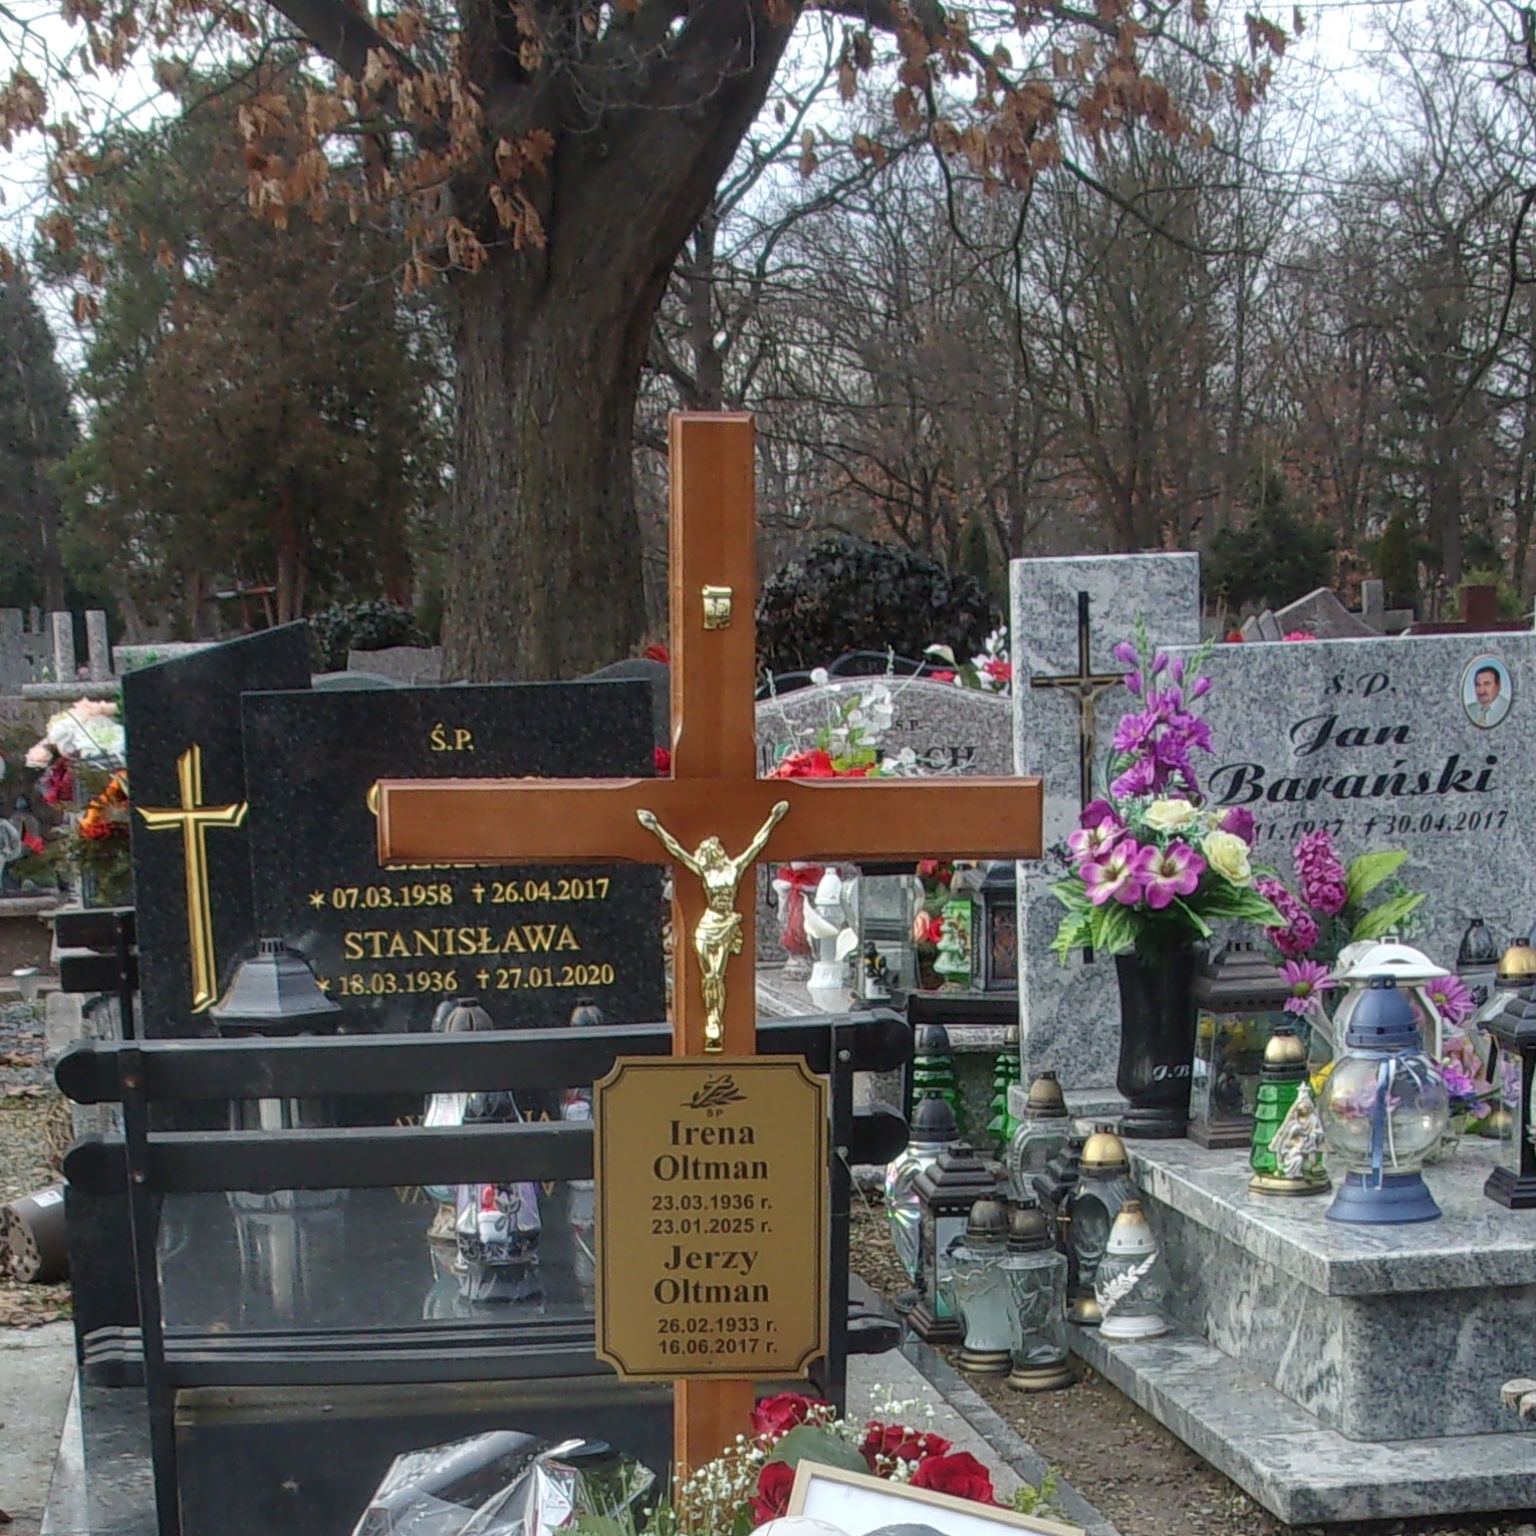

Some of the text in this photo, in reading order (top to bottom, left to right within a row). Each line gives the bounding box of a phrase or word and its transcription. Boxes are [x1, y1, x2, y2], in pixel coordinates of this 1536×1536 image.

[430, 722, 475, 751] Ś.P.
[1290, 714, 1414, 758] Jan
[1208, 753, 1498, 806] Barański
[1381, 810, 1509, 837] 30.04.2017
[331, 877, 611, 909] 07.03.1958 26.04.2017
[343, 923, 581, 960] STANISŁAWA
[339, 962, 615, 996] 18.03.1936 27.01.2020
[670, 1119, 756, 1147] Irena
[653, 1153, 769, 1181] Oltman
[651, 1195, 773, 1212] 23.03.1936 r.
[651, 1218, 773, 1235] 23.01.2025 r.
[663, 1245, 760, 1277] Jerzy
[653, 1278, 770, 1305] Oltman
[657, 1317, 778, 1334] 26.02.1933 r.
[658, 1338, 778, 1355] 16.06.2017 r.
